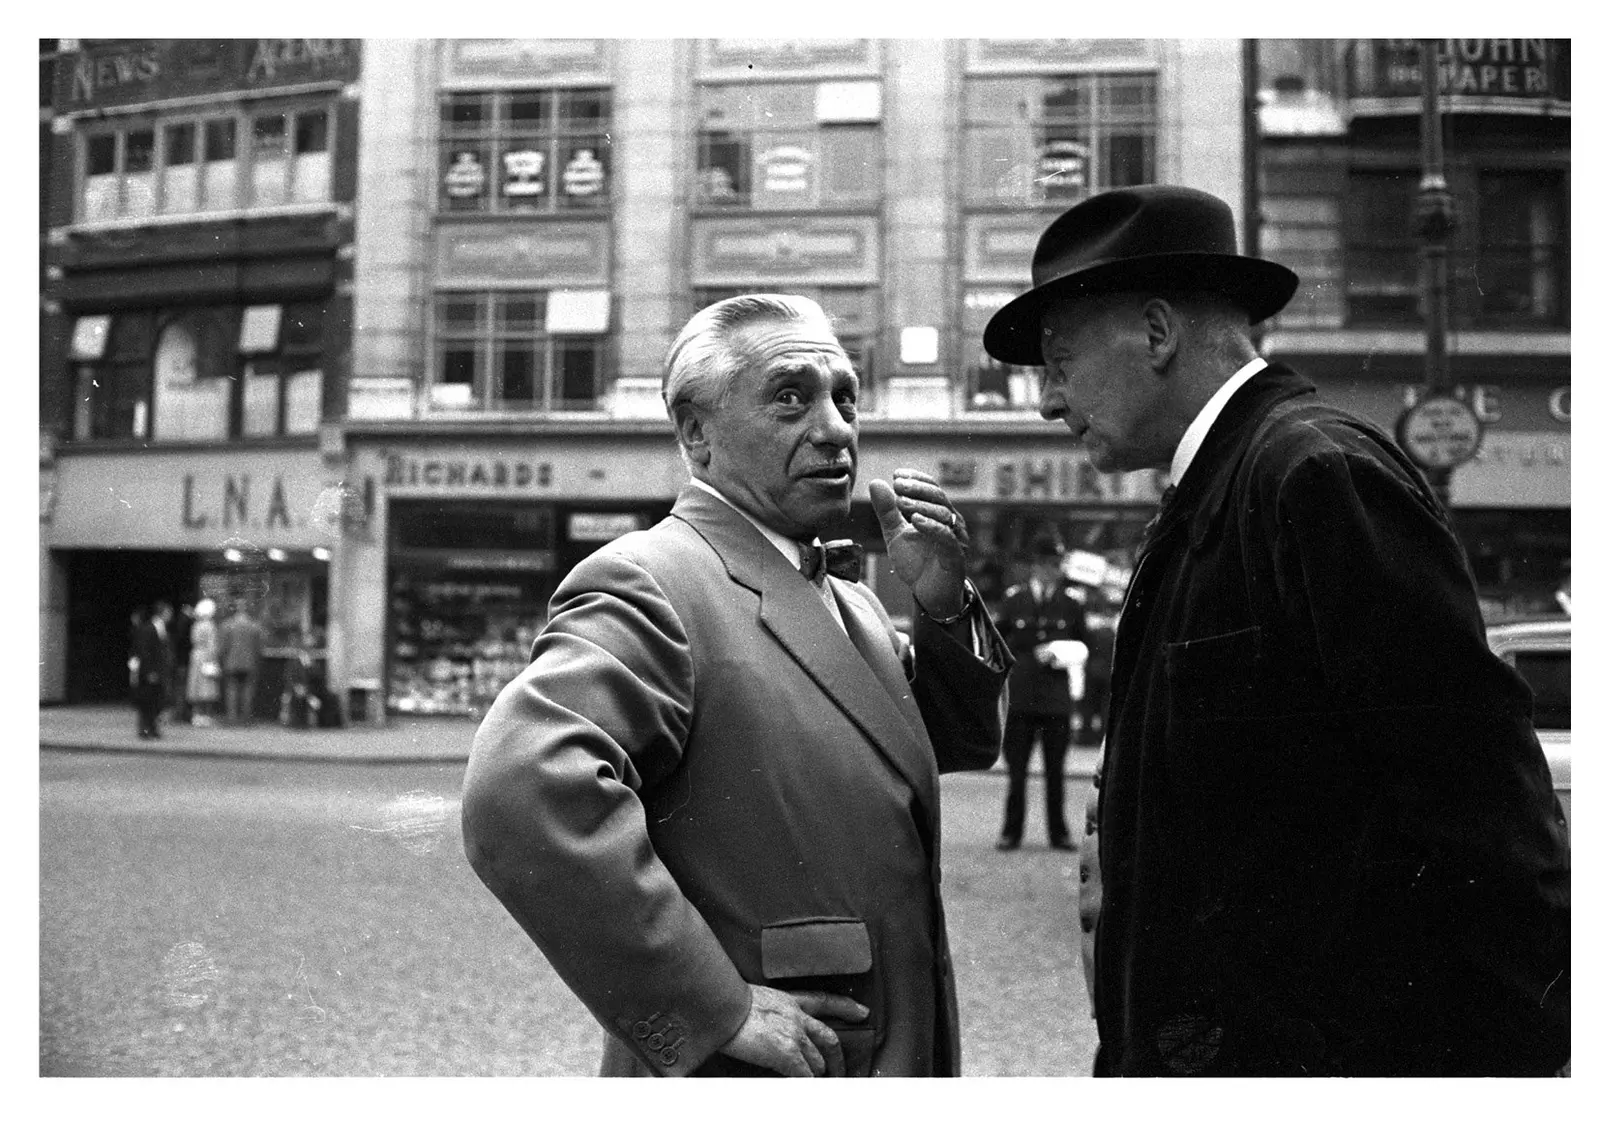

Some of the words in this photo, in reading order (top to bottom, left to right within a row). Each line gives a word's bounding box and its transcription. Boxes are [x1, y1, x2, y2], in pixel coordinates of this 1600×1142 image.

[1435, 38, 1546, 62] JOHN
[70, 51, 160, 102] NEWS
[1400, 384, 1502, 423] TE
[384, 454, 552, 487] RICHARDS
